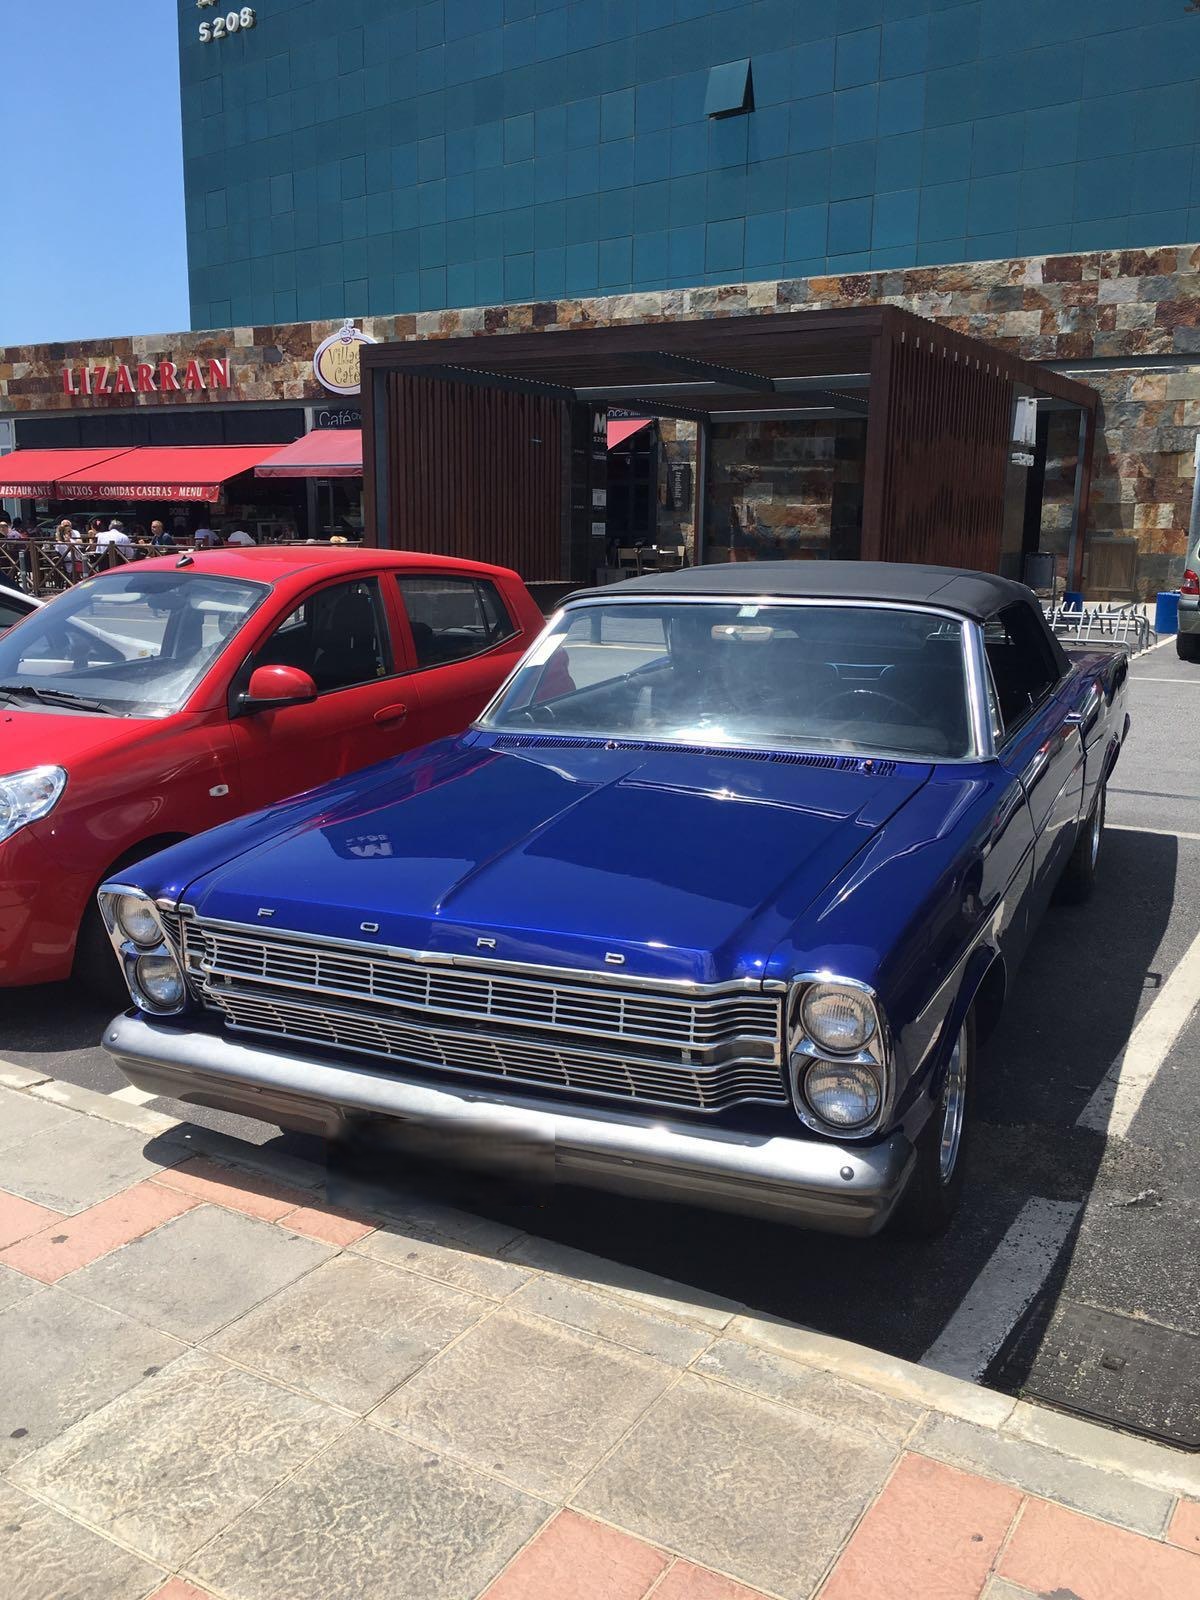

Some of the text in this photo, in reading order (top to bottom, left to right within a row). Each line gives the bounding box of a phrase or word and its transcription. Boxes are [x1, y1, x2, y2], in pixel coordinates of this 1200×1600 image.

[198, 6, 254, 43] S208
[63, 357, 232, 396] LIZARRAN
[319, 410, 352, 426] Café
[0, 485, 52, 496] RESTAURANTE
[59, 485, 94, 496] PINTXOS
[99, 485, 135, 497] COMIDAS
[137, 486, 172, 497] CASERAS
[178, 486, 203, 497] MENU
[256, 907, 626, 965] FORD
